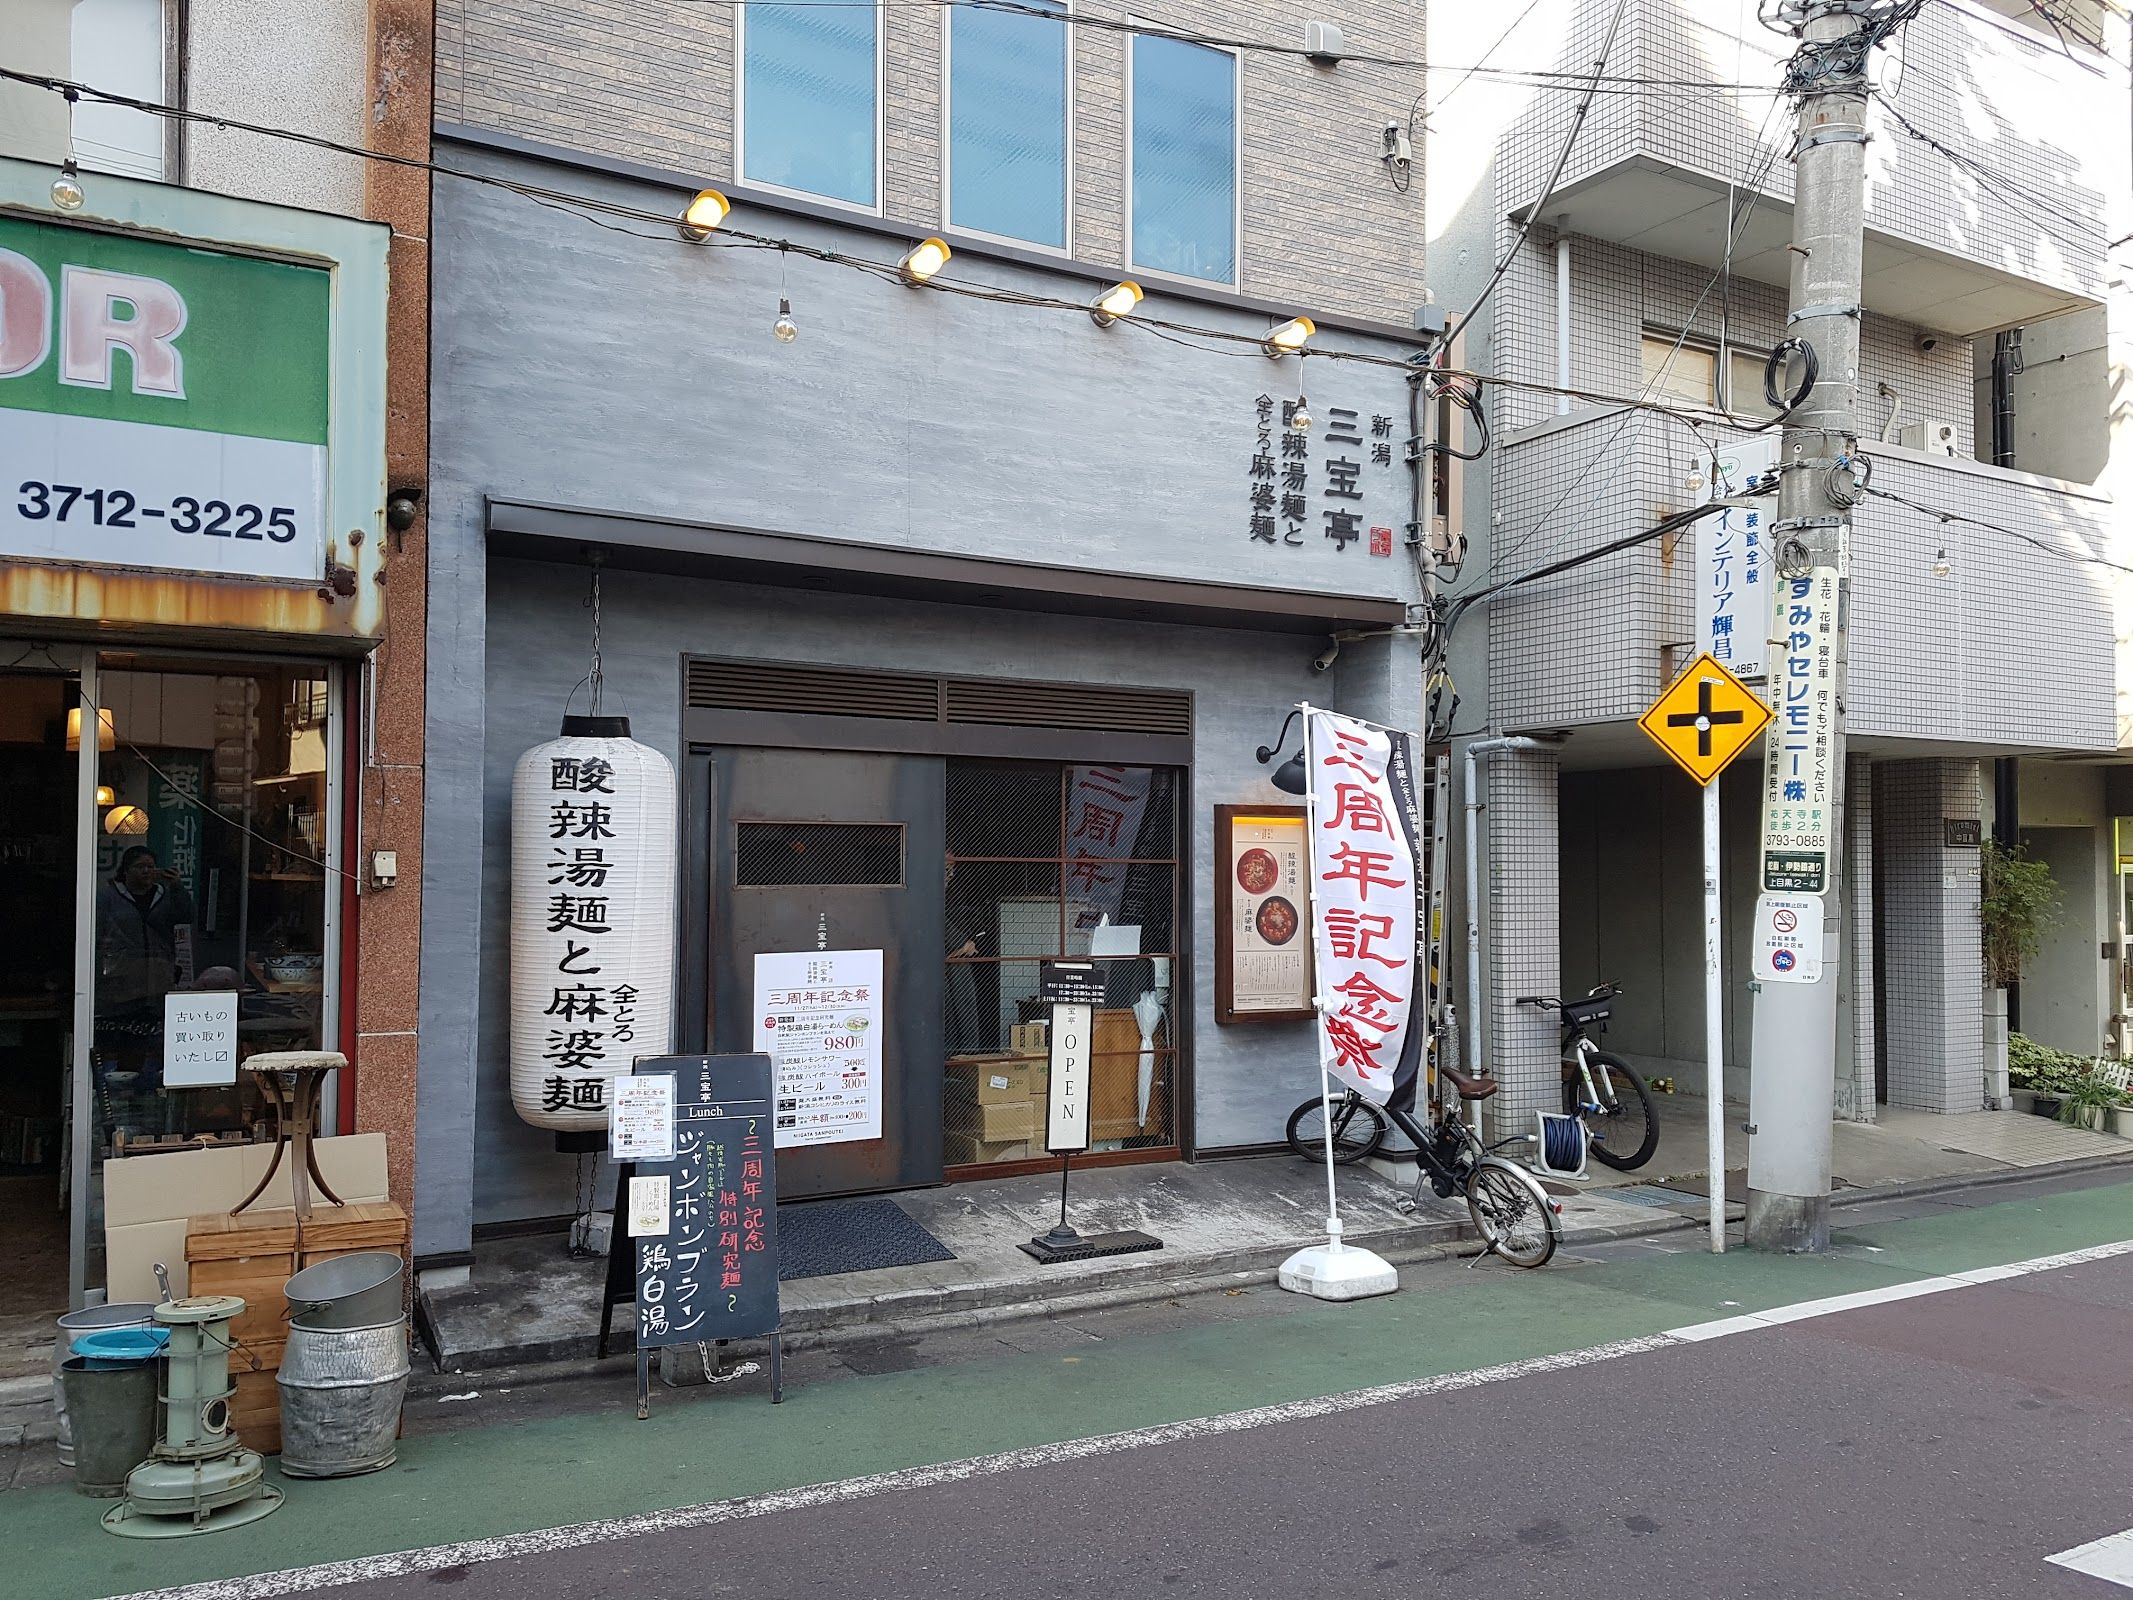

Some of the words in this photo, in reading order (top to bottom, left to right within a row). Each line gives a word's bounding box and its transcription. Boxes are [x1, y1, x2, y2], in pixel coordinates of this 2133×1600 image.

[1249, 393, 1277, 544] 全とろ麻婆麺
[1371, 413, 1394, 467] 新潟
[1323, 407, 1363, 550] 三宝亭
[17, 481, 297, 543] 3712-3225
[1746, 475, 1759, 584] 室装飾全般
[1711, 508, 1735, 660] インテリア輝昌
[1724, 663, 1759, 675] -4867
[1814, 690, 1829, 803] 何でもご相談ください
[1766, 834, 1826, 847] 3793-0885
[1770, 821, 1822, 831] 徒歩2分
[541, 756, 617, 1113] 酸辣湯麺と麻婆麺
[1322, 729, 1407, 1080] 三周年記念祭
[175, 1011, 228, 1023] 古いもの
[610, 983, 640, 1043] 全とろ
[767, 989, 870, 1006] 三周年記念祭
[175, 1031, 225, 1043] 買い取り
[824, 1035, 864, 1051] 980円
[700, 1072, 712, 1103] 三宝亭
[777, 1082, 826, 1095] 生ビール
[1062, 1034, 1077, 1120] OPEN
[689, 1106, 723, 1118] Lunch
[675, 1131, 709, 1331] ジャンボンブラン
[637, 1244, 671, 1338] 鶏白湯
